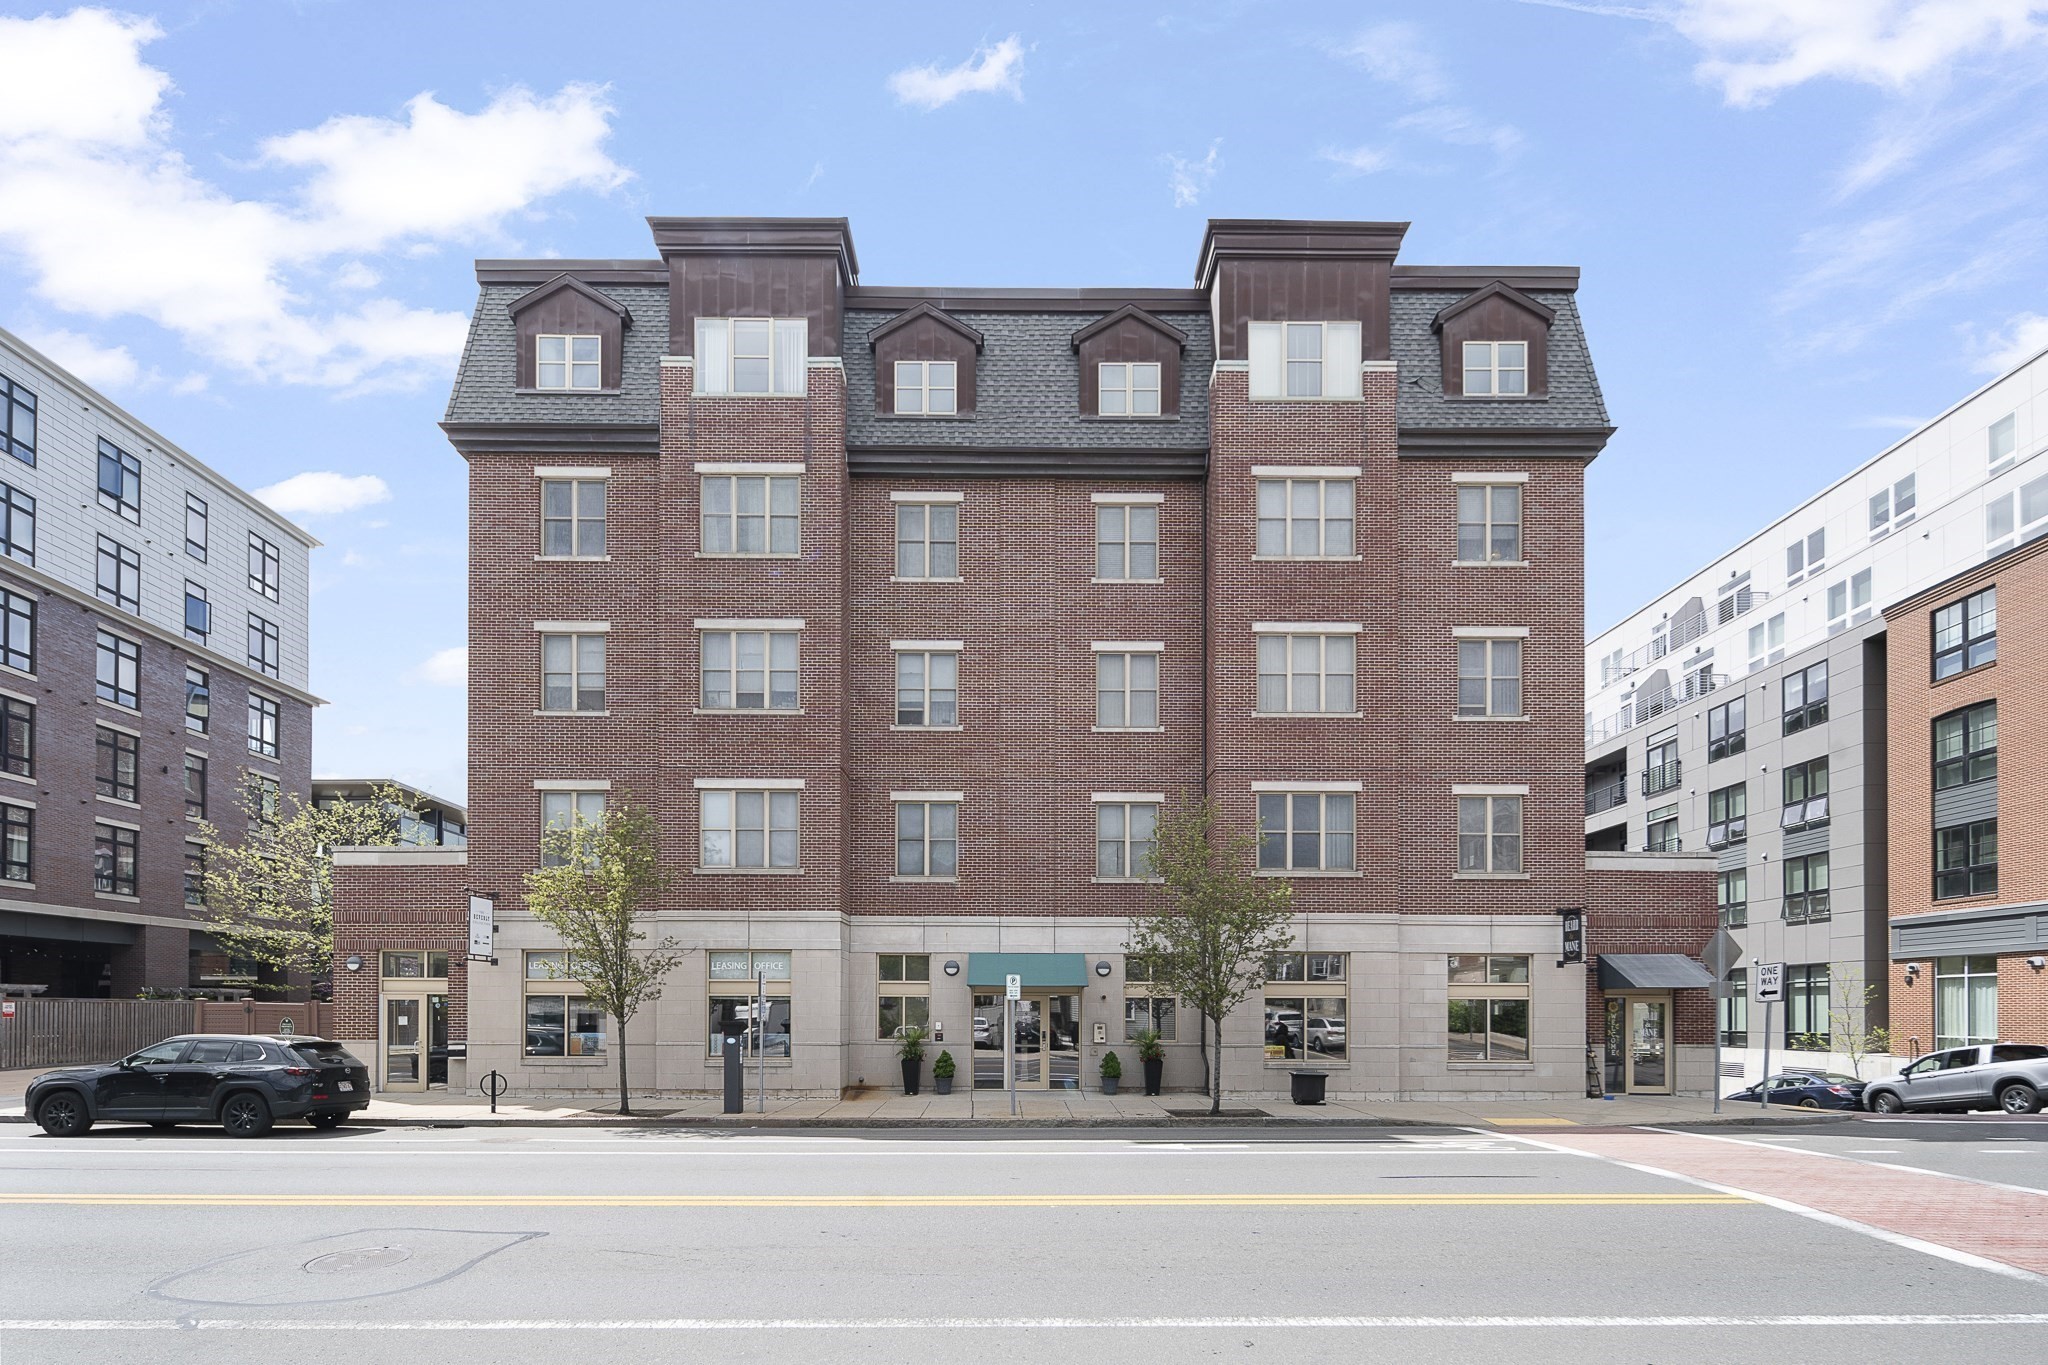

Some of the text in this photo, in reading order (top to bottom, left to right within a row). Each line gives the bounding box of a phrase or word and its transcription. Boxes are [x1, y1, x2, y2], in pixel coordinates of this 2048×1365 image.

[1564, 940, 1580, 952] MANE
[528, 961, 564, 970] LEASNG
[711, 961, 783, 970] LEASING OFFICE
[1761, 966, 1778, 976] ONE
[1761, 976, 1778, 986] WAY
